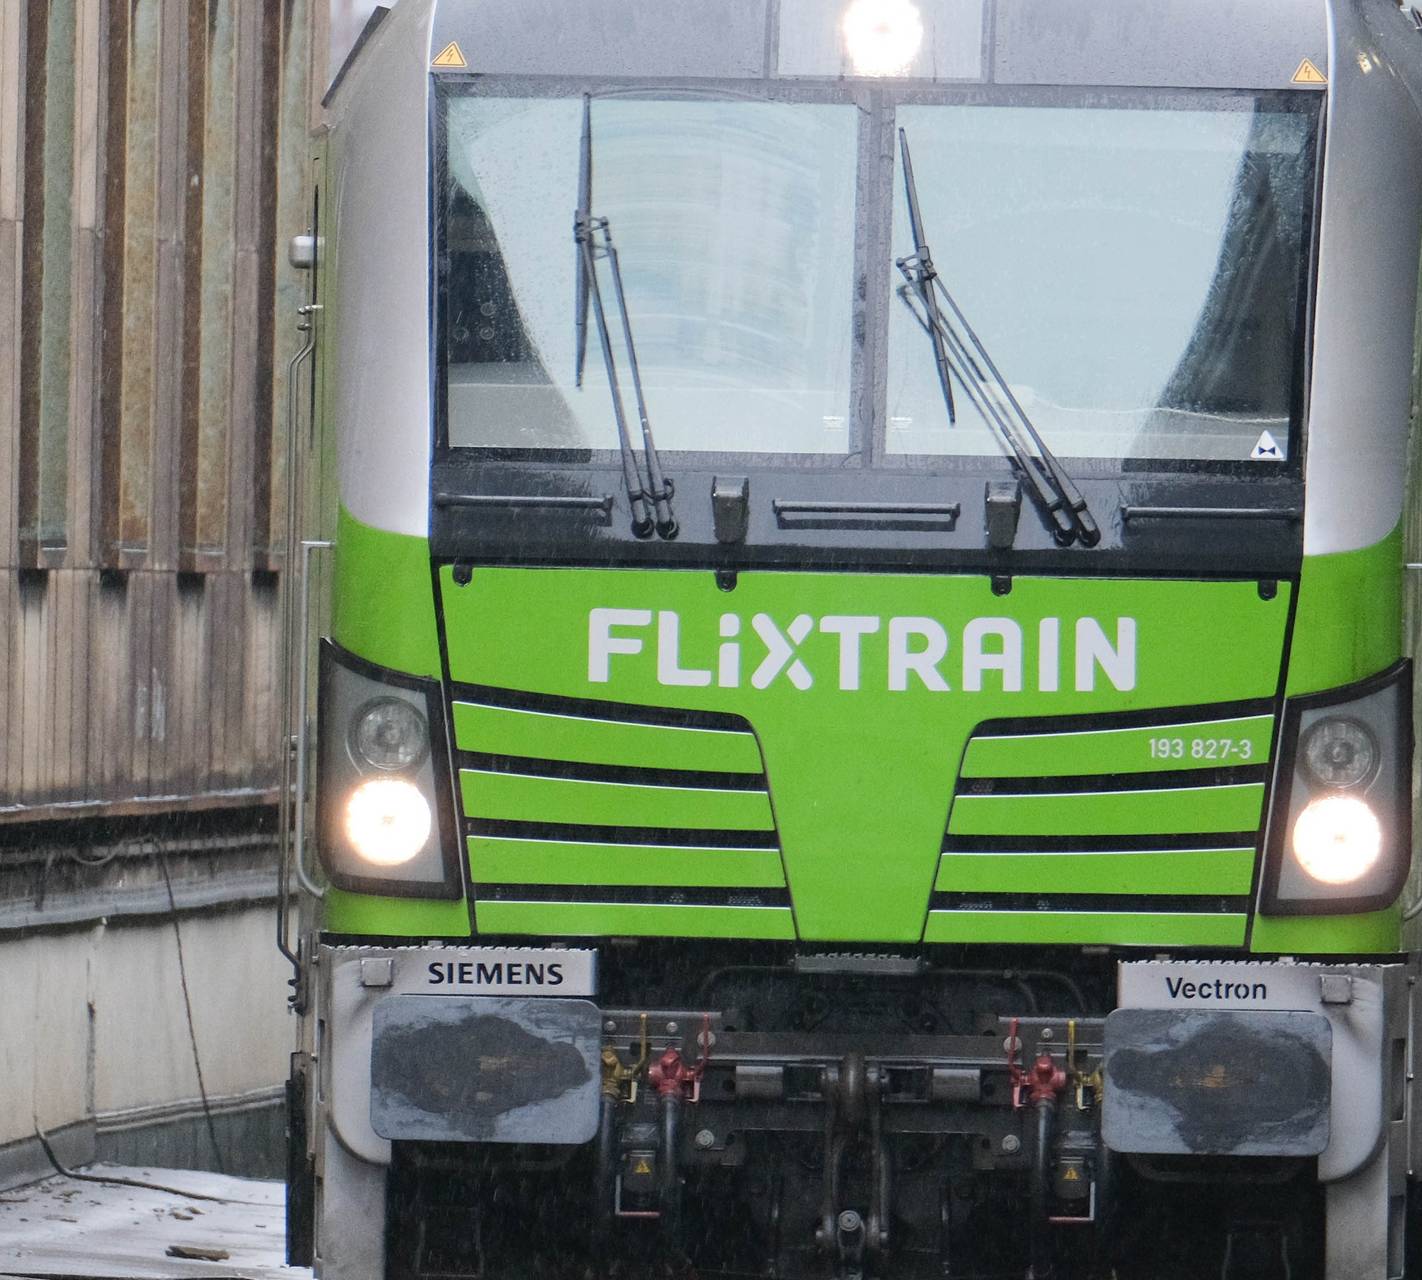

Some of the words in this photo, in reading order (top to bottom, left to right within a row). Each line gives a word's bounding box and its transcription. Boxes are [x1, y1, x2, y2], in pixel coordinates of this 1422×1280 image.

[1149, 738, 1184, 759] 193
[1191, 739, 1252, 760] 827-3
[428, 962, 563, 985] SIEMENS
[1165, 976, 1267, 1000] Vectron
